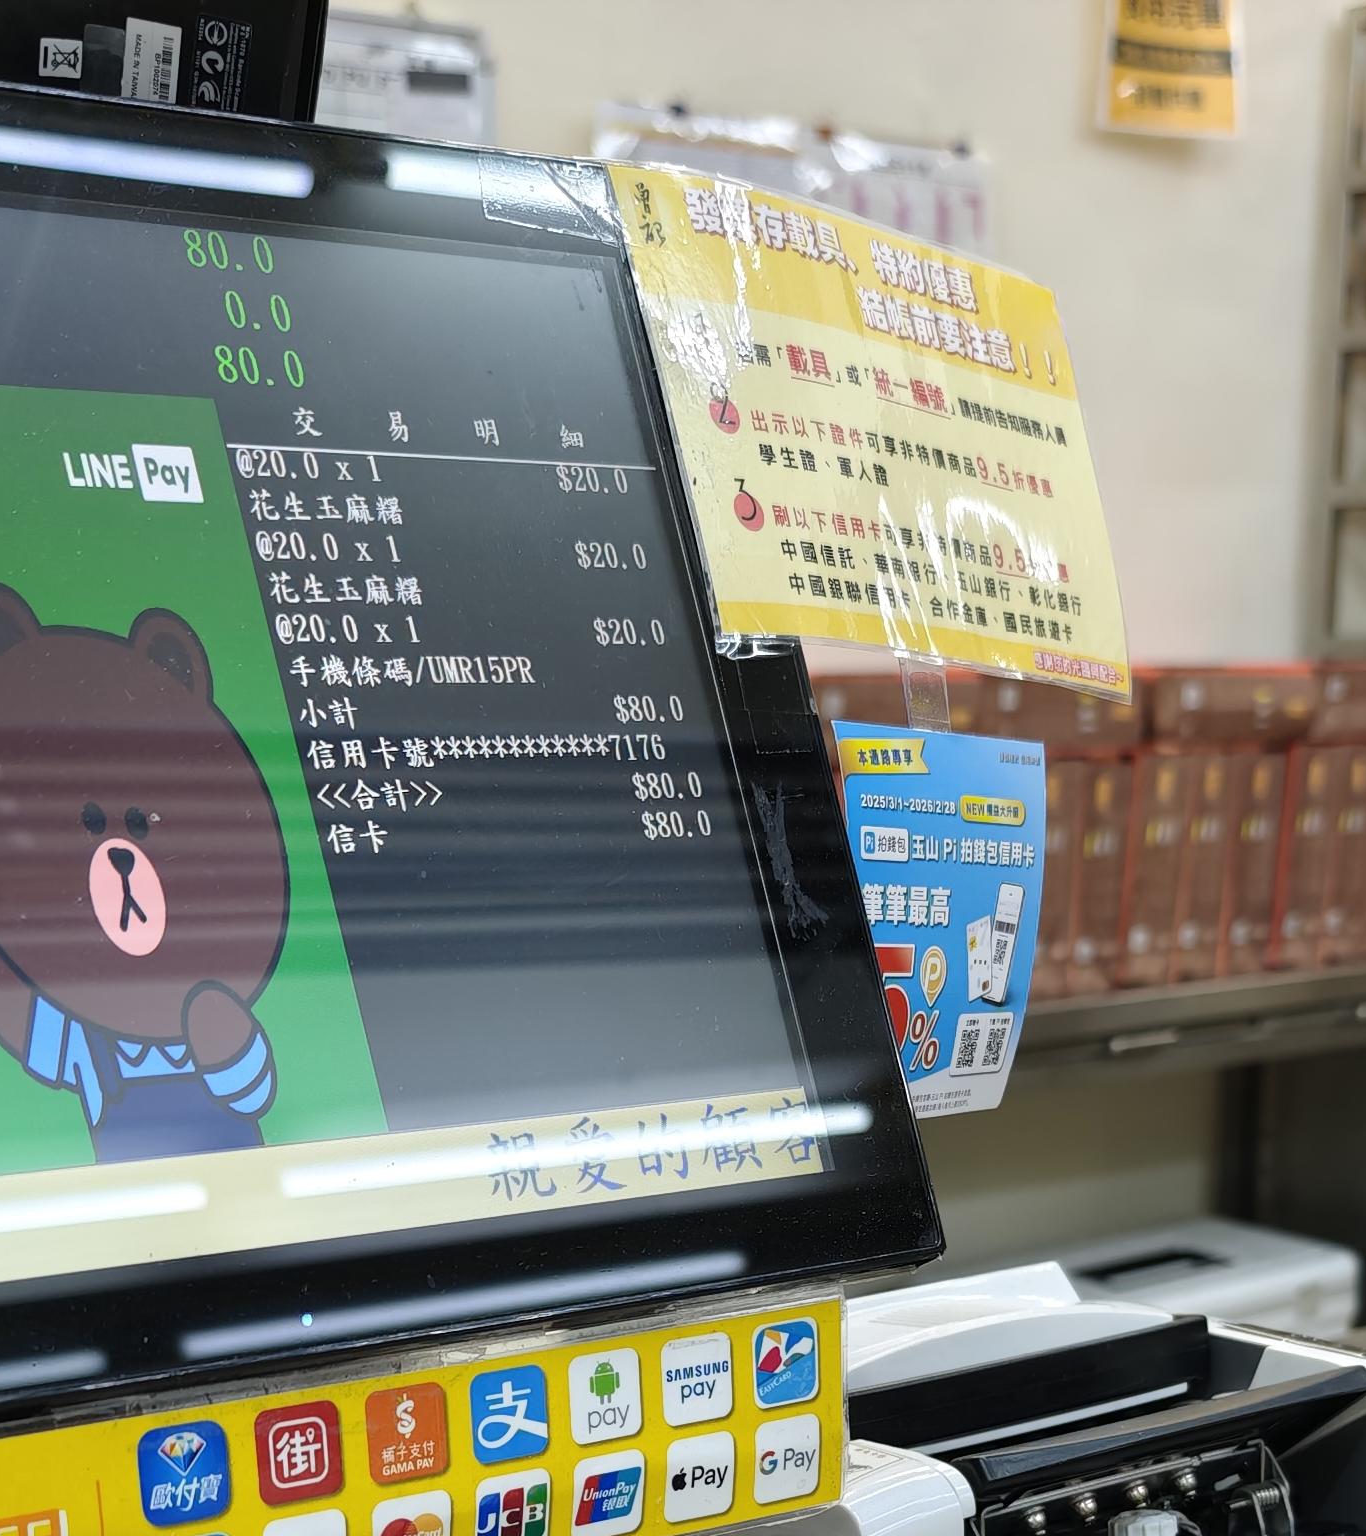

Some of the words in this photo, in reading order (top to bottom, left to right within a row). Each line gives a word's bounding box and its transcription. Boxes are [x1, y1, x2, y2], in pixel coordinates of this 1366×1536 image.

[183, 227, 276, 274] 80.0
[224, 289, 292, 333] 0.0
[214, 345, 305, 388] 80.0
[62, 451, 134, 490] LINE
[145, 459, 195, 494] Pay
[235, 447, 320, 482] @20.0
[556, 466, 629, 495] $20.0
[255, 529, 339, 563] @20.0
[574, 541, 647, 570] $20.0
[275, 613, 358, 645] @20.0
[593, 618, 665, 646] $20.0
[299, 697, 358, 730] 小計
[613, 695, 685, 725] $80.0
[631, 772, 703, 802] $80.0
[965, 802, 985, 817] NEW
[326, 820, 389, 856] 信卡
[642, 810, 712, 840] $80.0
[911, 834, 939, 861] 玉山
[943, 838, 958, 862] Pi
[861, 882, 952, 927] 筆筆最高
[666, 1359, 730, 1384] SAMSUNG
[680, 1379, 717, 1403] pay
[588, 1404, 630, 1434] pay
[381, 1460, 415, 1477] GAMA
[416, 1456, 435, 1472] PAY
[783, 1447, 817, 1472] Pay
[149, 1472, 223, 1512] 歐付寶
[583, 1480, 637, 1502] UnionPay
[690, 1464, 729, 1489] Pay
